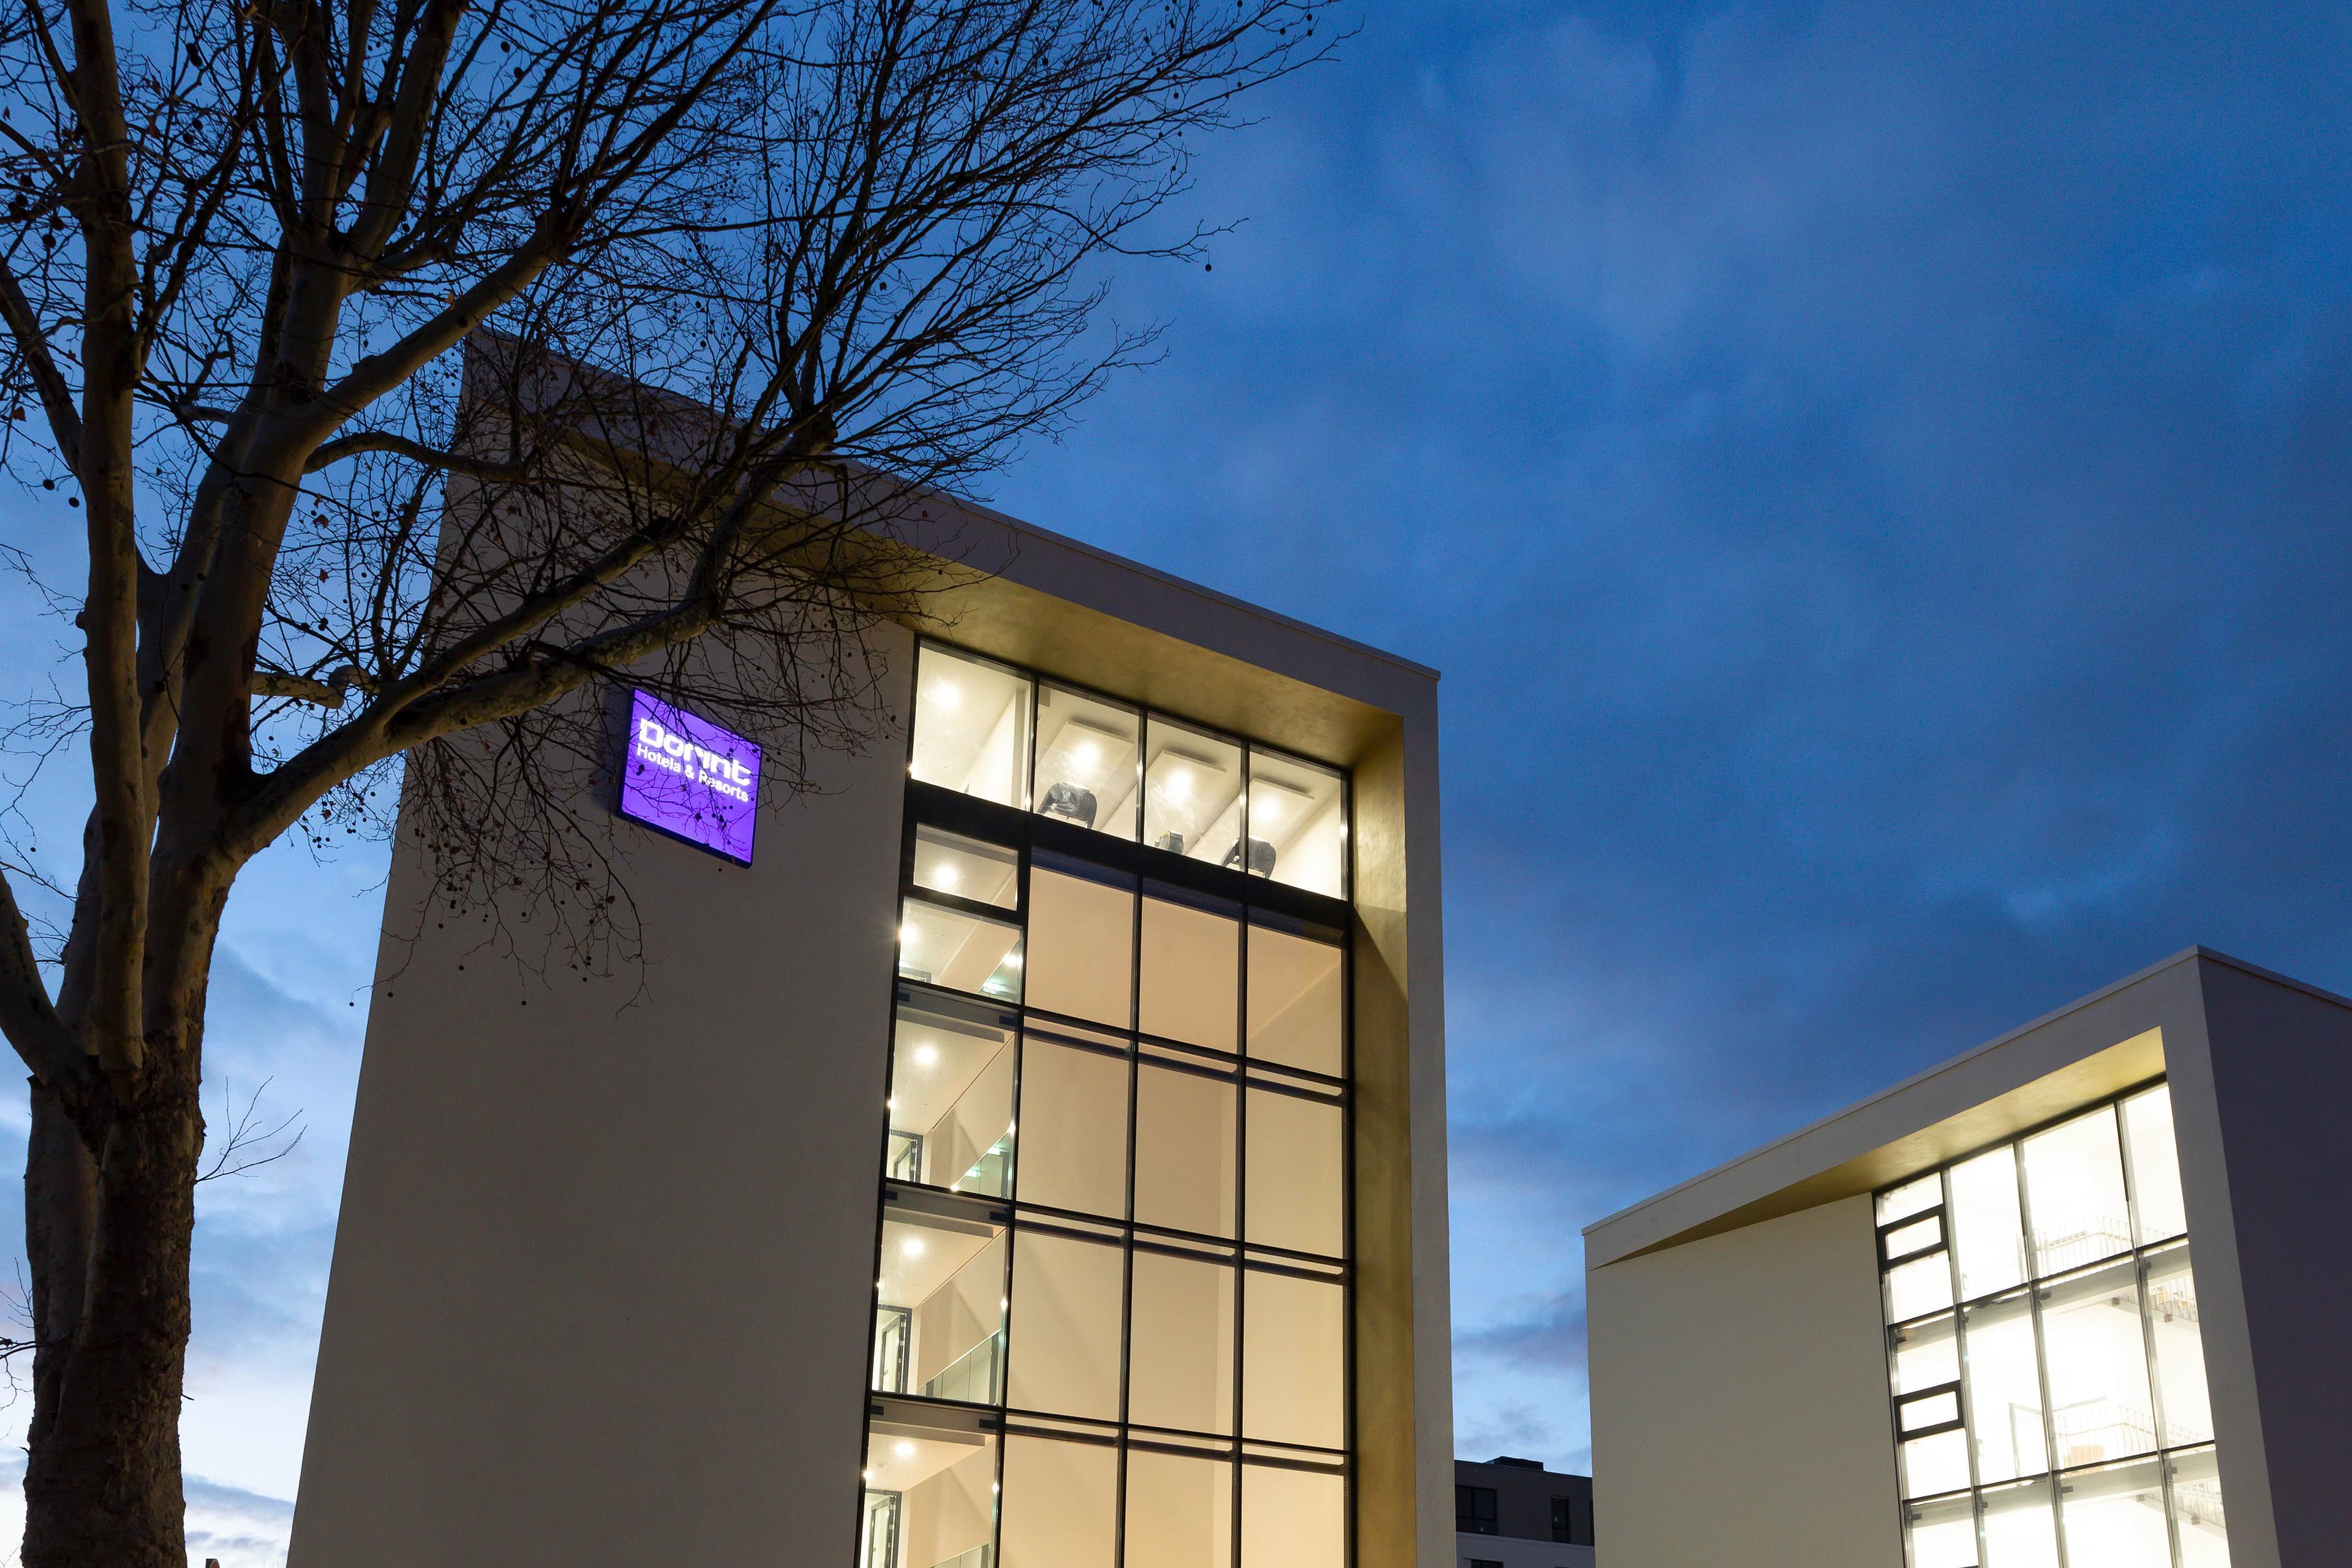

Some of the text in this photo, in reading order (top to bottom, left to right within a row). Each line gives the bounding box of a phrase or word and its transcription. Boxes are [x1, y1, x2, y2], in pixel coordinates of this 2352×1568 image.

[637, 743, 748, 802] Hotels & Resorts
[639, 718, 751, 786] Dorint
